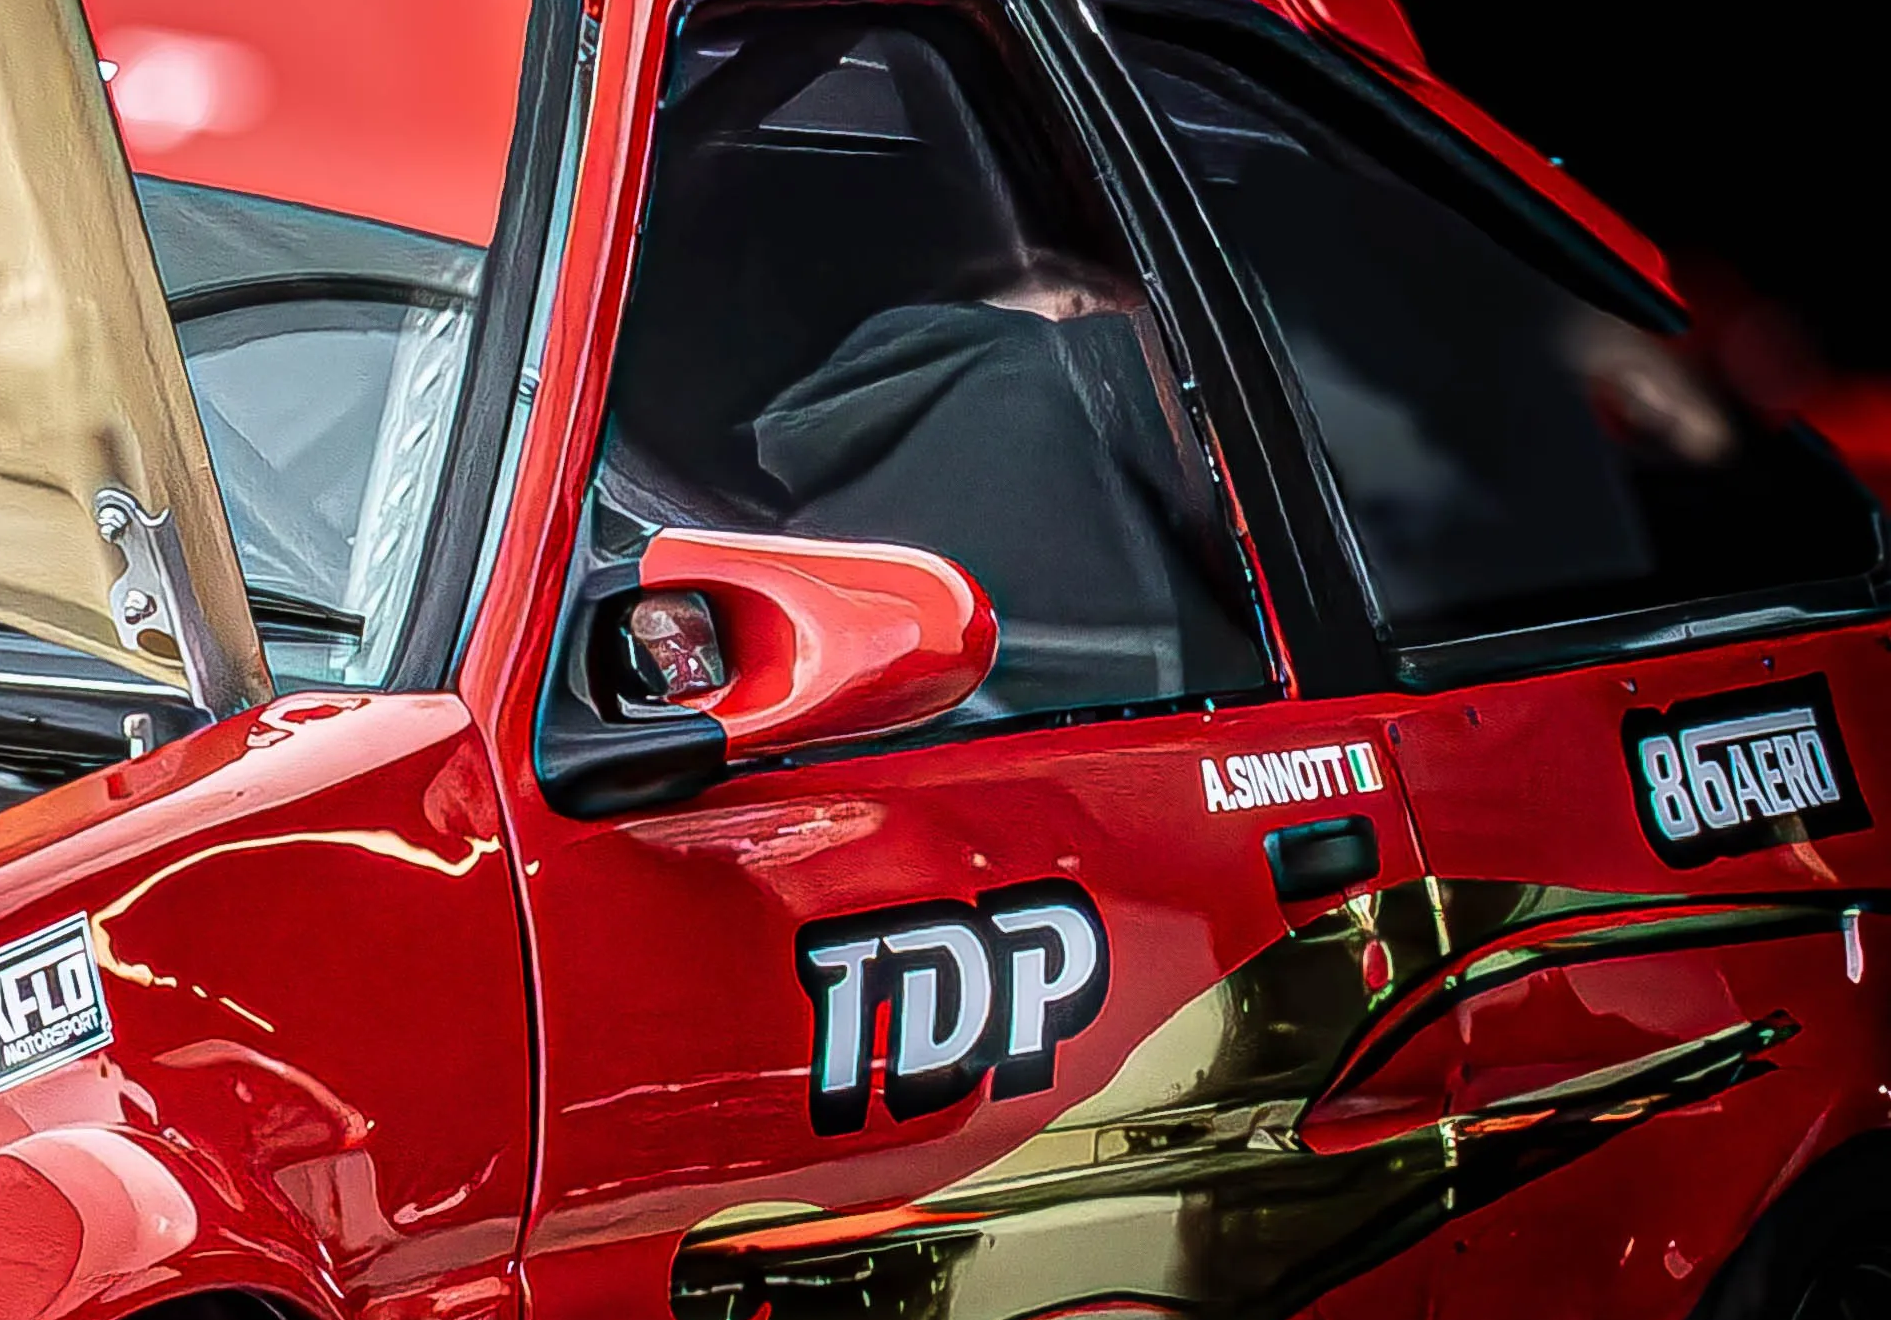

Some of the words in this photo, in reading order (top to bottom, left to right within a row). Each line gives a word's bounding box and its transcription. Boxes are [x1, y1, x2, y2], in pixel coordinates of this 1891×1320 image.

[1202, 746, 1351, 813] A.SINNOTT
[809, 905, 1098, 1092] TDP
[3, 1008, 100, 1066] MOTORSPORT
